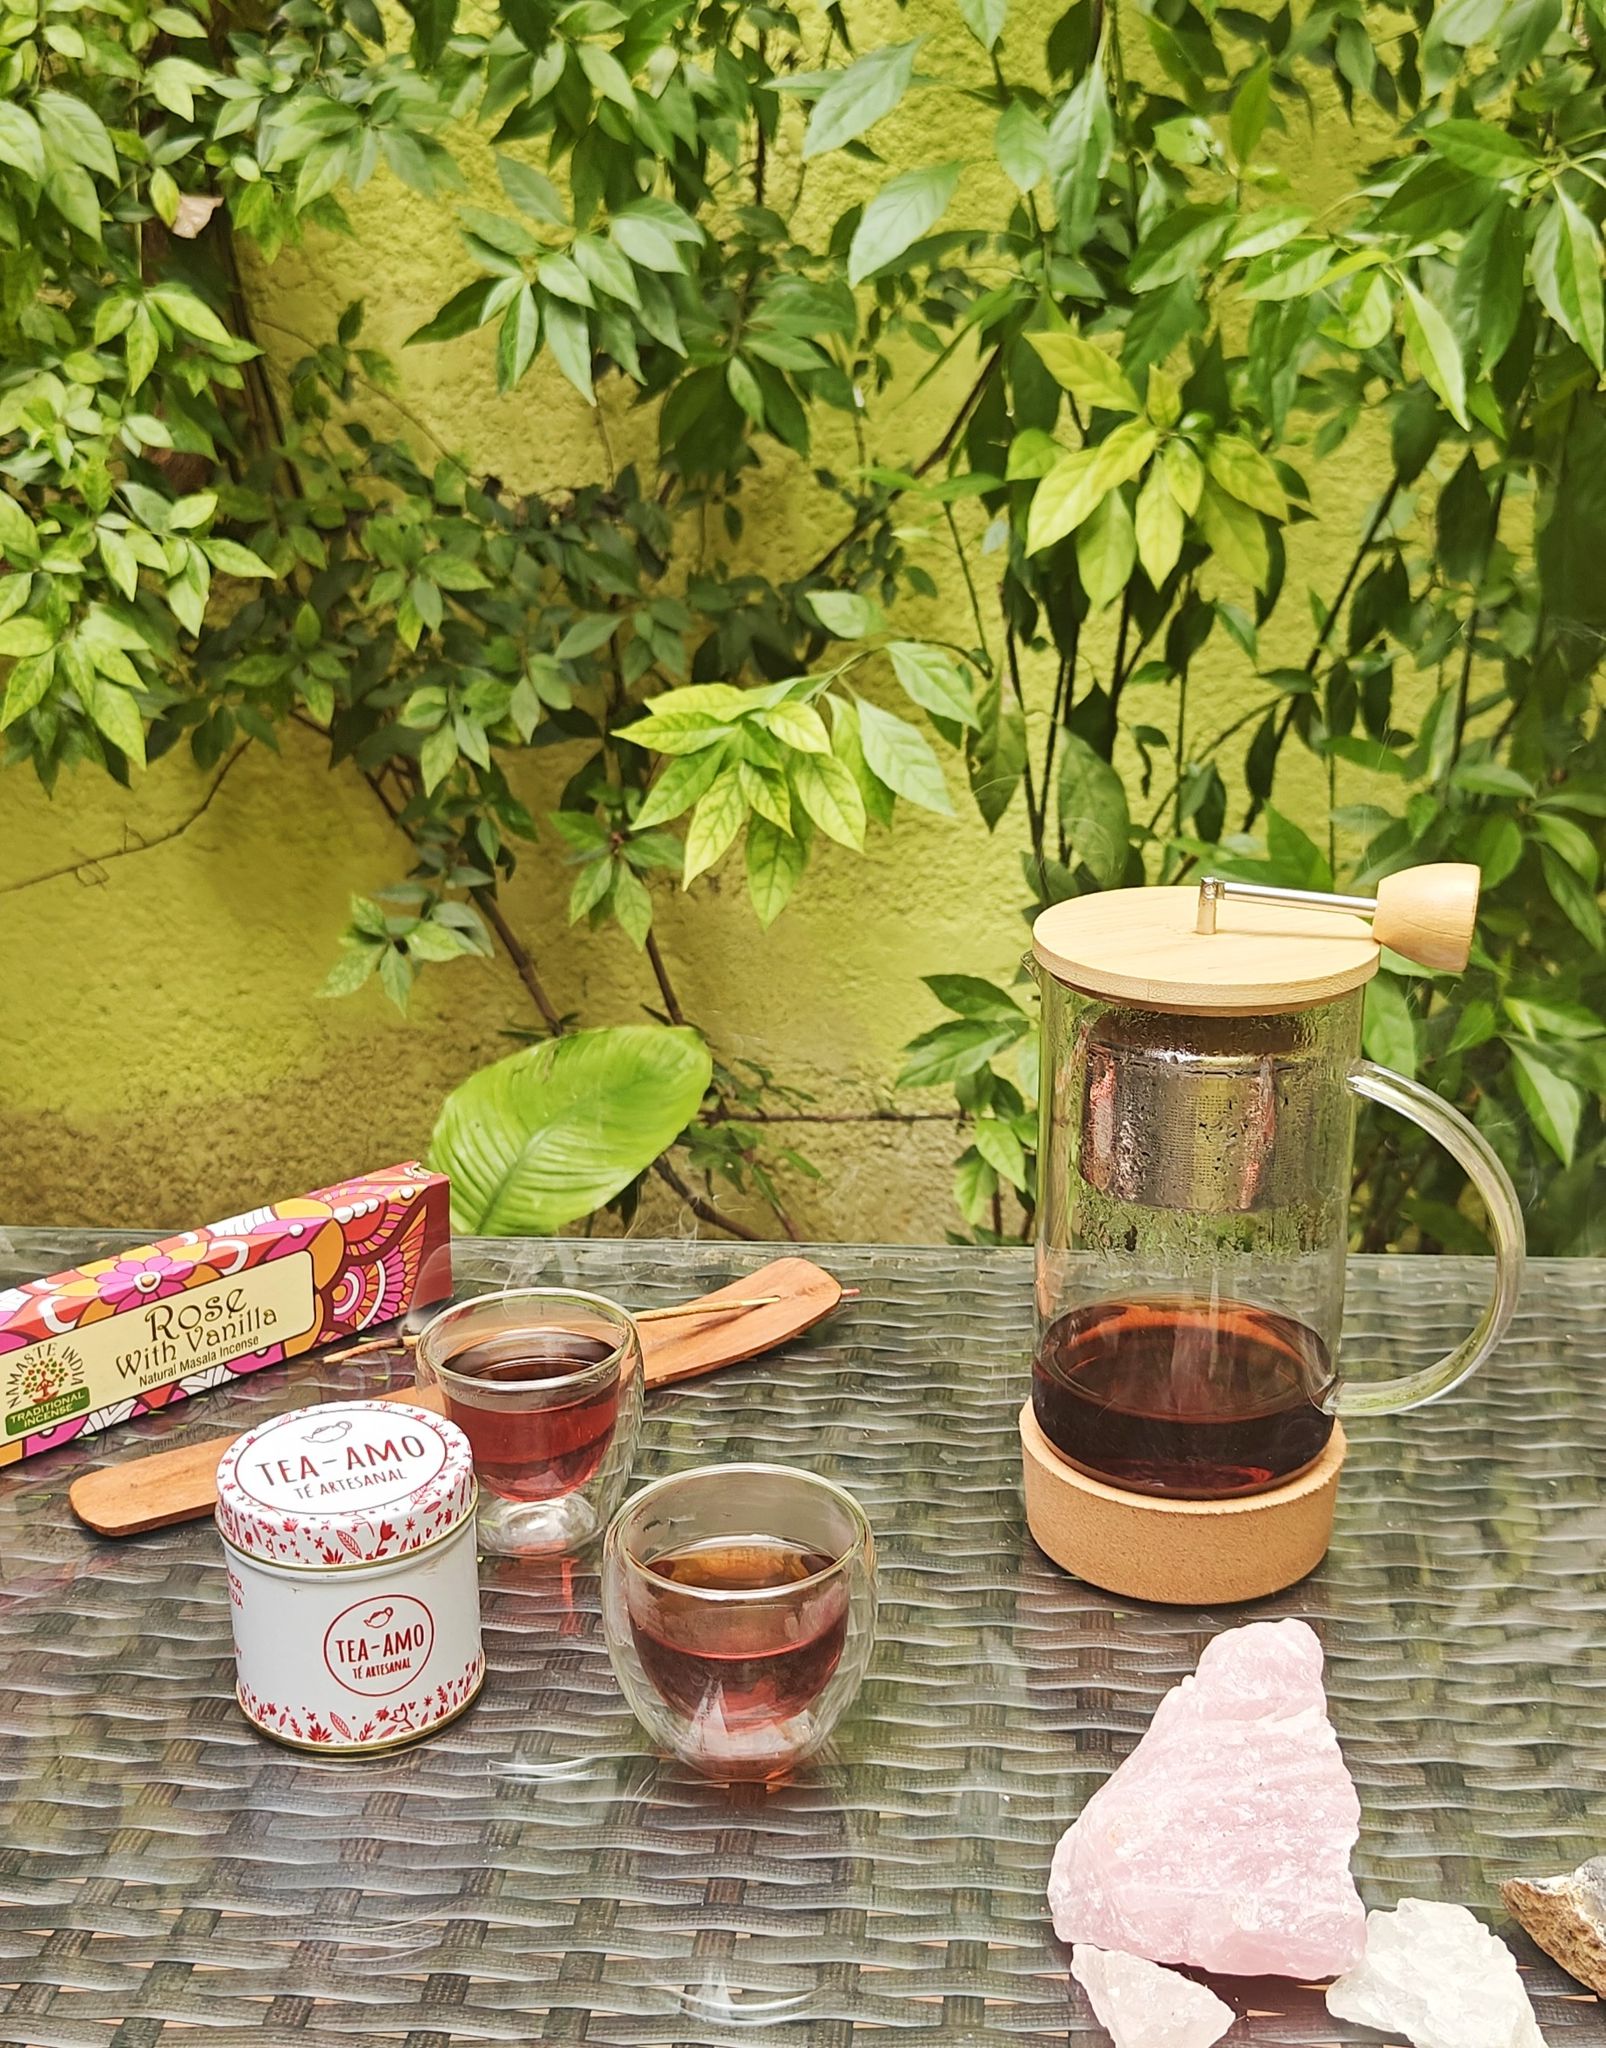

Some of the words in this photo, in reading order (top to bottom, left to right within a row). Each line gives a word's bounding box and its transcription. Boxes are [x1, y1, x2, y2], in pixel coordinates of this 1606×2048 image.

[144, 1288, 248, 1342] Rose
[115, 1340, 177, 1380] With
[186, 1307, 278, 1353] Vanilla
[139, 1365, 177, 1388] Natural
[179, 1352, 217, 1373] Masala
[219, 1335, 259, 1359] Incense
[5, 1342, 58, 1409] NAMASTE
[61, 1346, 85, 1386] INDIA
[9, 1391, 86, 1424] TRADITIONAL
[23, 1404, 74, 1428] INCENSE
[254, 1435, 426, 1487] TEA-AMO
[319, 1468, 408, 1496] ARTESANAL
[334, 1623, 425, 1664] TEA-AMO
[352, 1664, 363, 1680] TÉ
[365, 1656, 412, 1679] ARTESANAL
